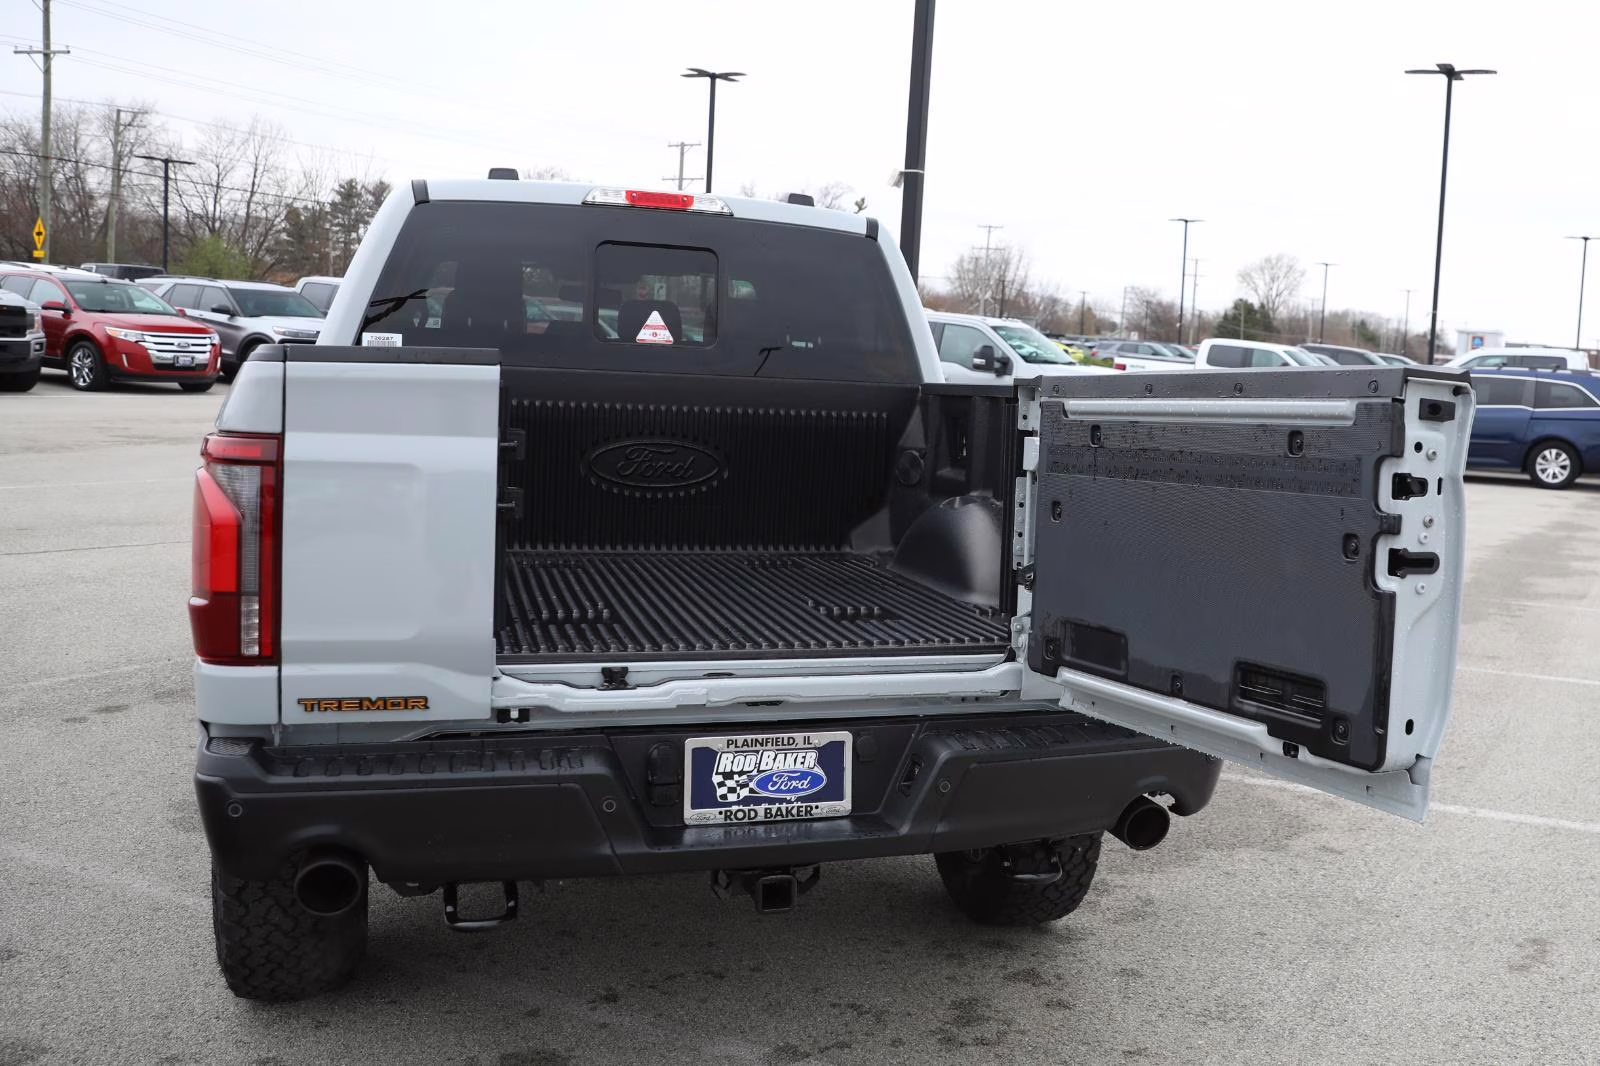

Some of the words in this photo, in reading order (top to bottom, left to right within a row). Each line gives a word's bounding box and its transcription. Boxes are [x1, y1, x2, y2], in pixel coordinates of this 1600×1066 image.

[616, 446, 695, 478] Ford
[297, 695, 430, 712] TREMOR
[726, 737, 799, 749] PLAINFIELD,
[803, 736, 813, 746] IL
[759, 750, 817, 772] BAKER
[768, 772, 811, 791] Ford
[723, 808, 759, 822] ROD
[763, 802, 815, 819] BAKER
